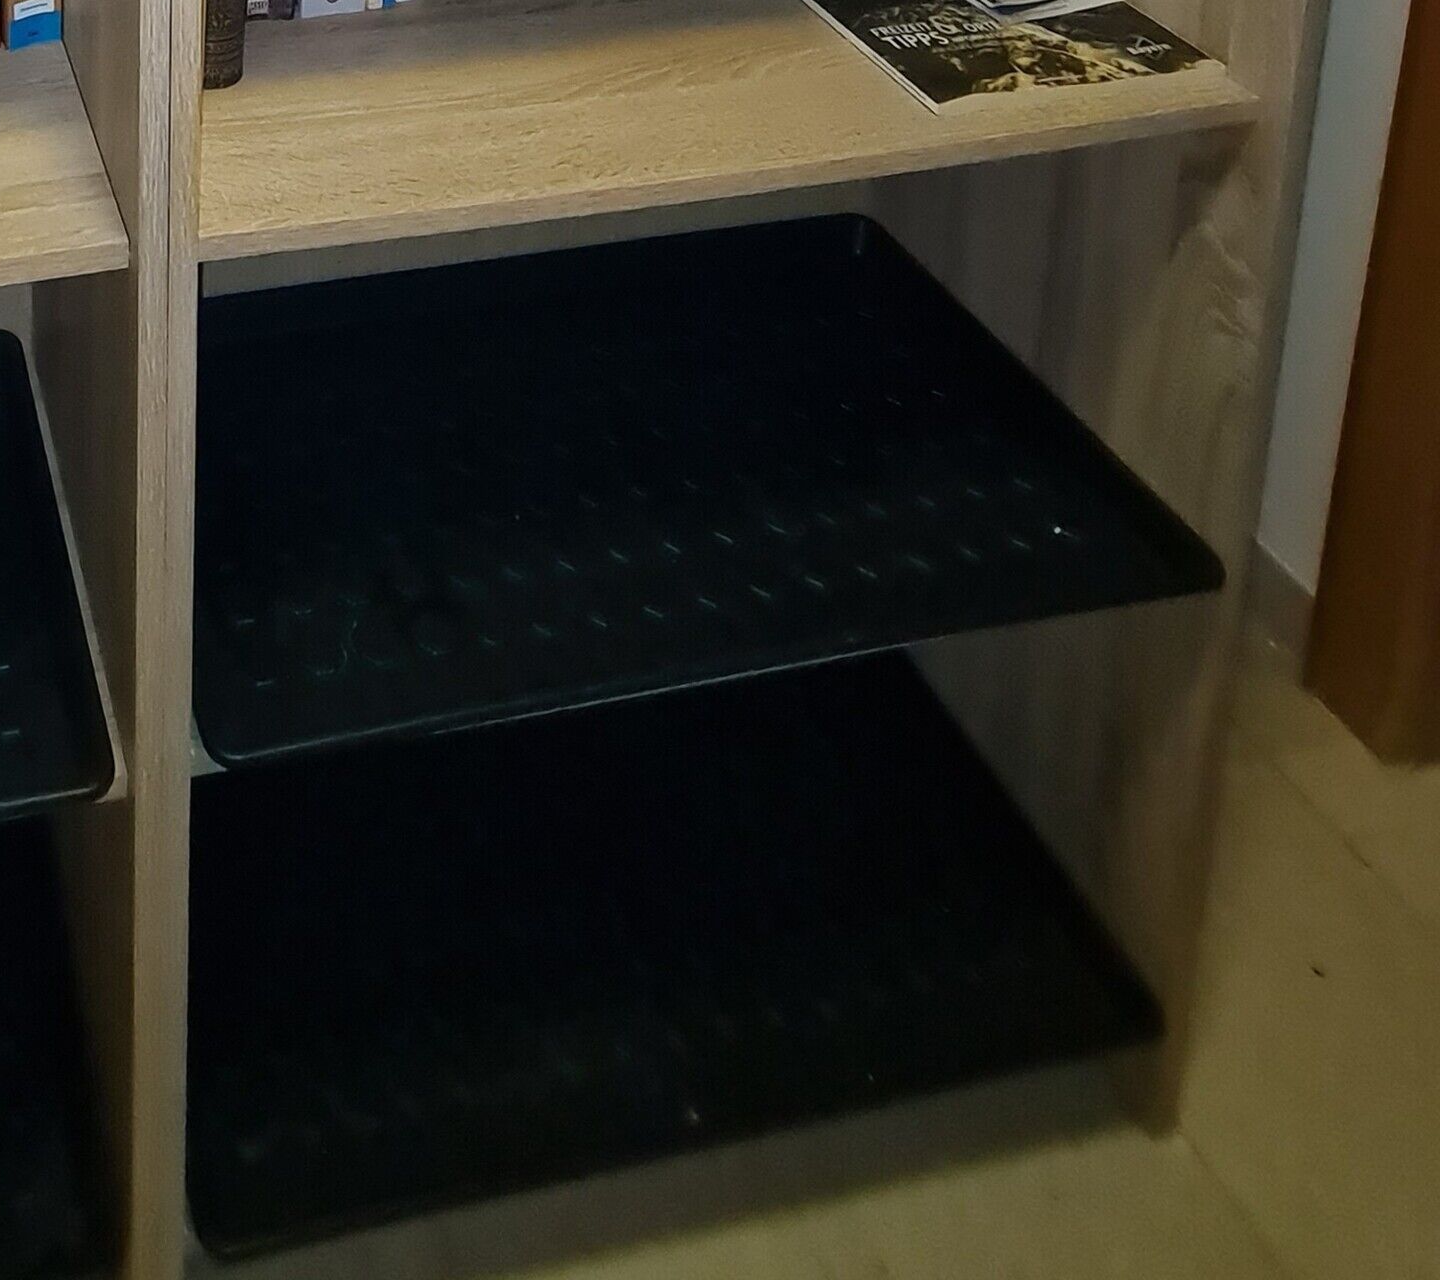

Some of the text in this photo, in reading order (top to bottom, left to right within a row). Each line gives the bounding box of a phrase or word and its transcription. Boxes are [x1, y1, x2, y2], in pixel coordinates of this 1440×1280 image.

[870, 21, 931, 38] FREIZEIT
[929, 14, 961, 36] &
[879, 30, 950, 51] TIPPS
